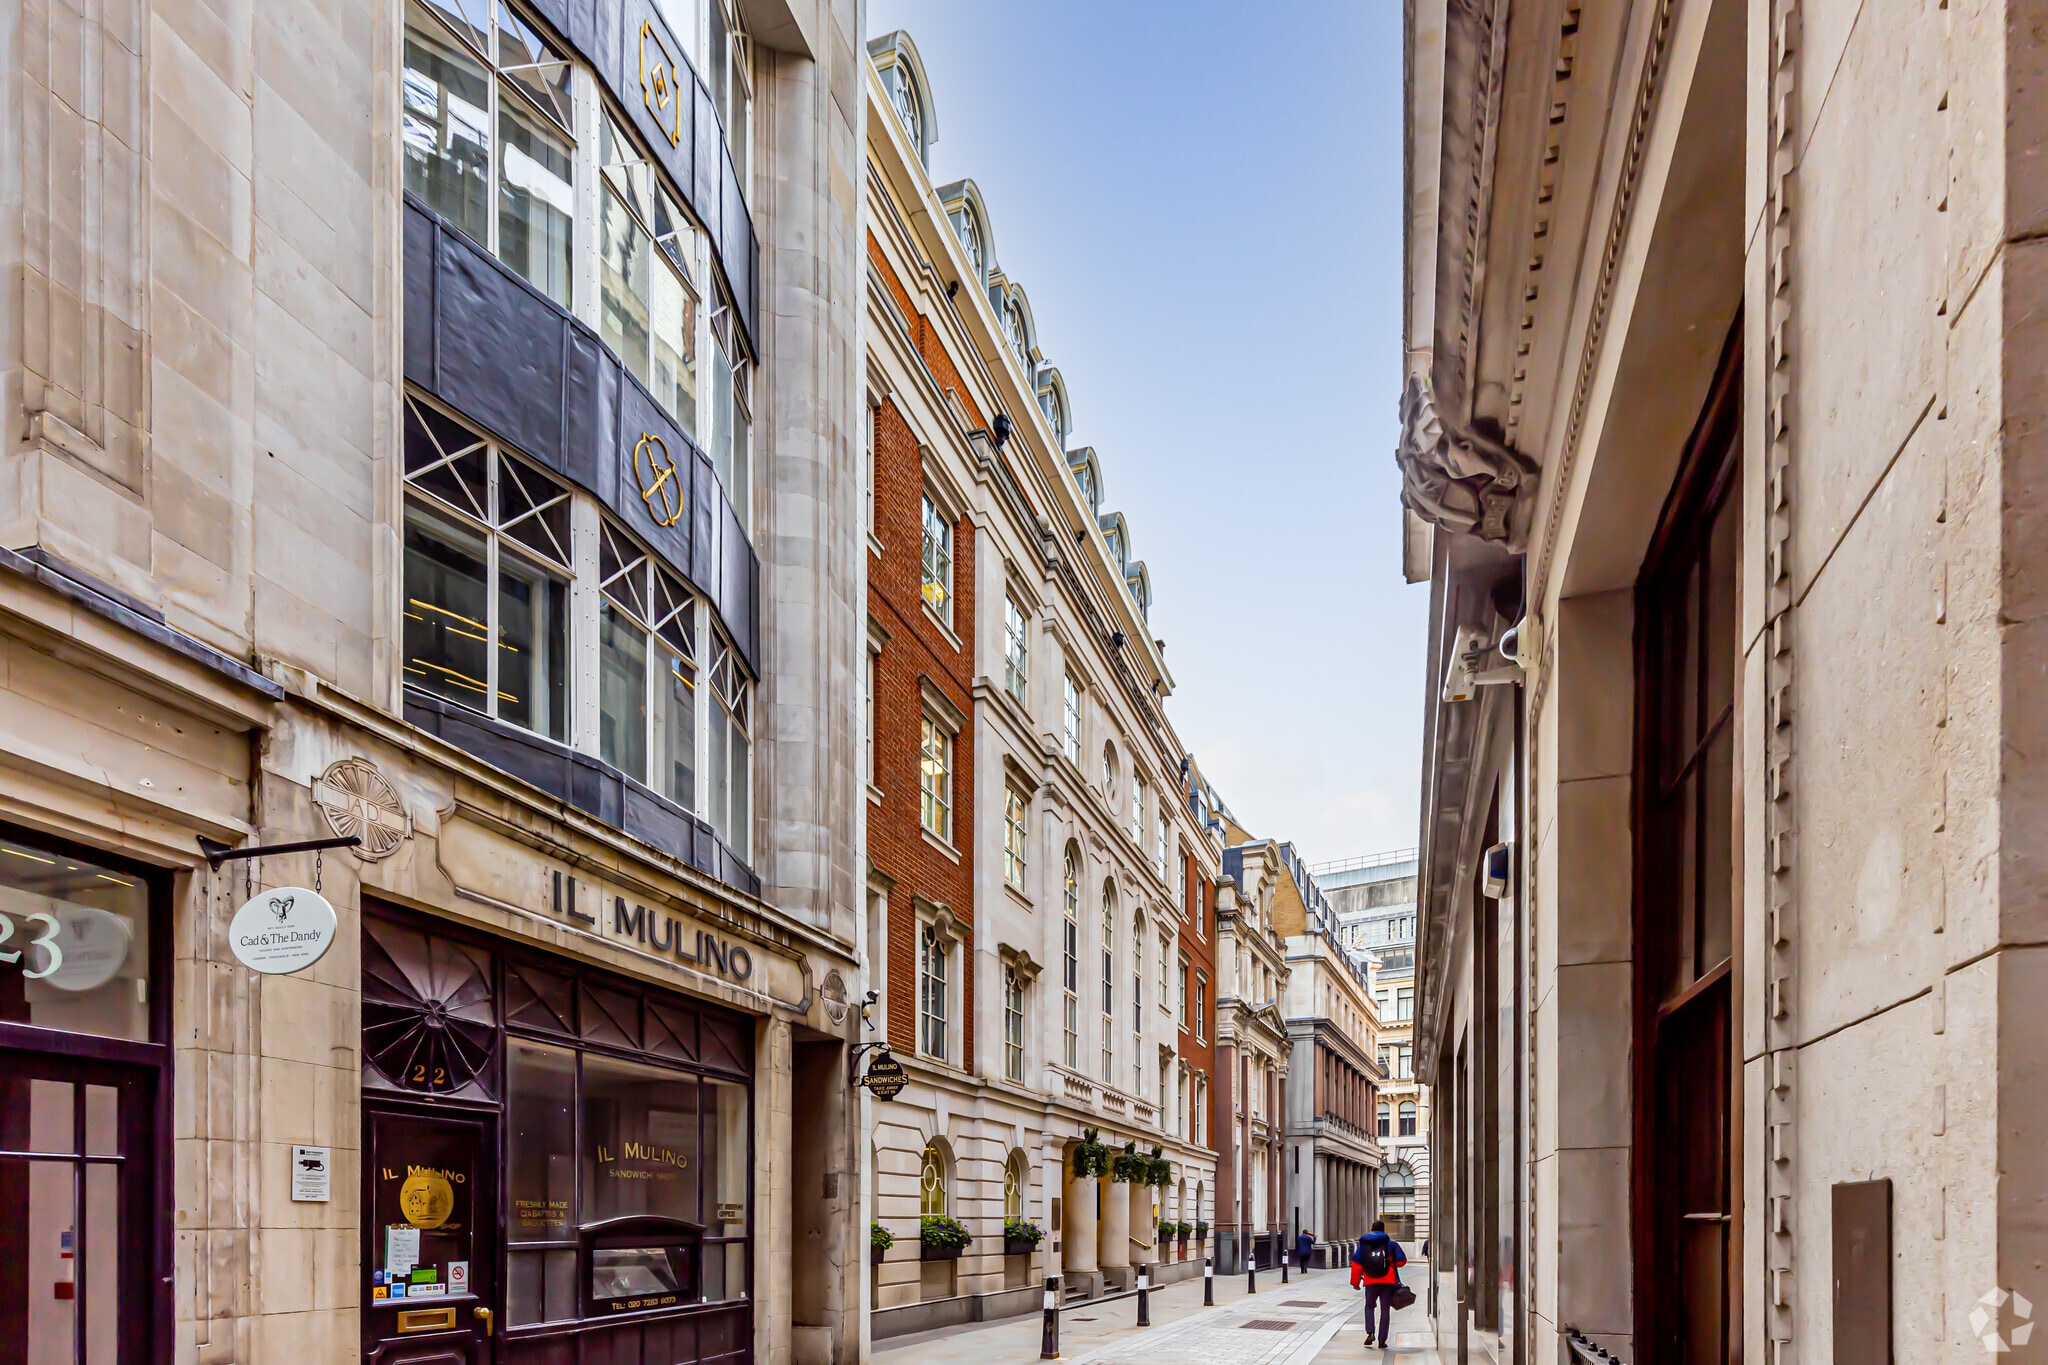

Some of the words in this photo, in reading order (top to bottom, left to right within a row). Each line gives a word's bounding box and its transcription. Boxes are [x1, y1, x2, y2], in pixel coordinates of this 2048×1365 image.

[553, 870, 596, 926] IL
[615, 895, 753, 981] MULINO
[240, 935, 259, 947] Cad
[260, 933, 270, 946] &
[269, 933, 289, 944] The
[290, 929, 321, 942] Dandy
[412, 1064, 445, 1085] 22
[863, 1075, 907, 1085] SANDWICHES
[598, 1145, 614, 1163] IL
[625, 1142, 688, 1169] MULINO
[382, 1167, 399, 1181] IL
[407, 1165, 466, 1184] MULINO
[609, 1169, 653, 1179] SANDWICH
[549, 1201, 569, 1209] MADE
[627, 1300, 641, 1309] 020
